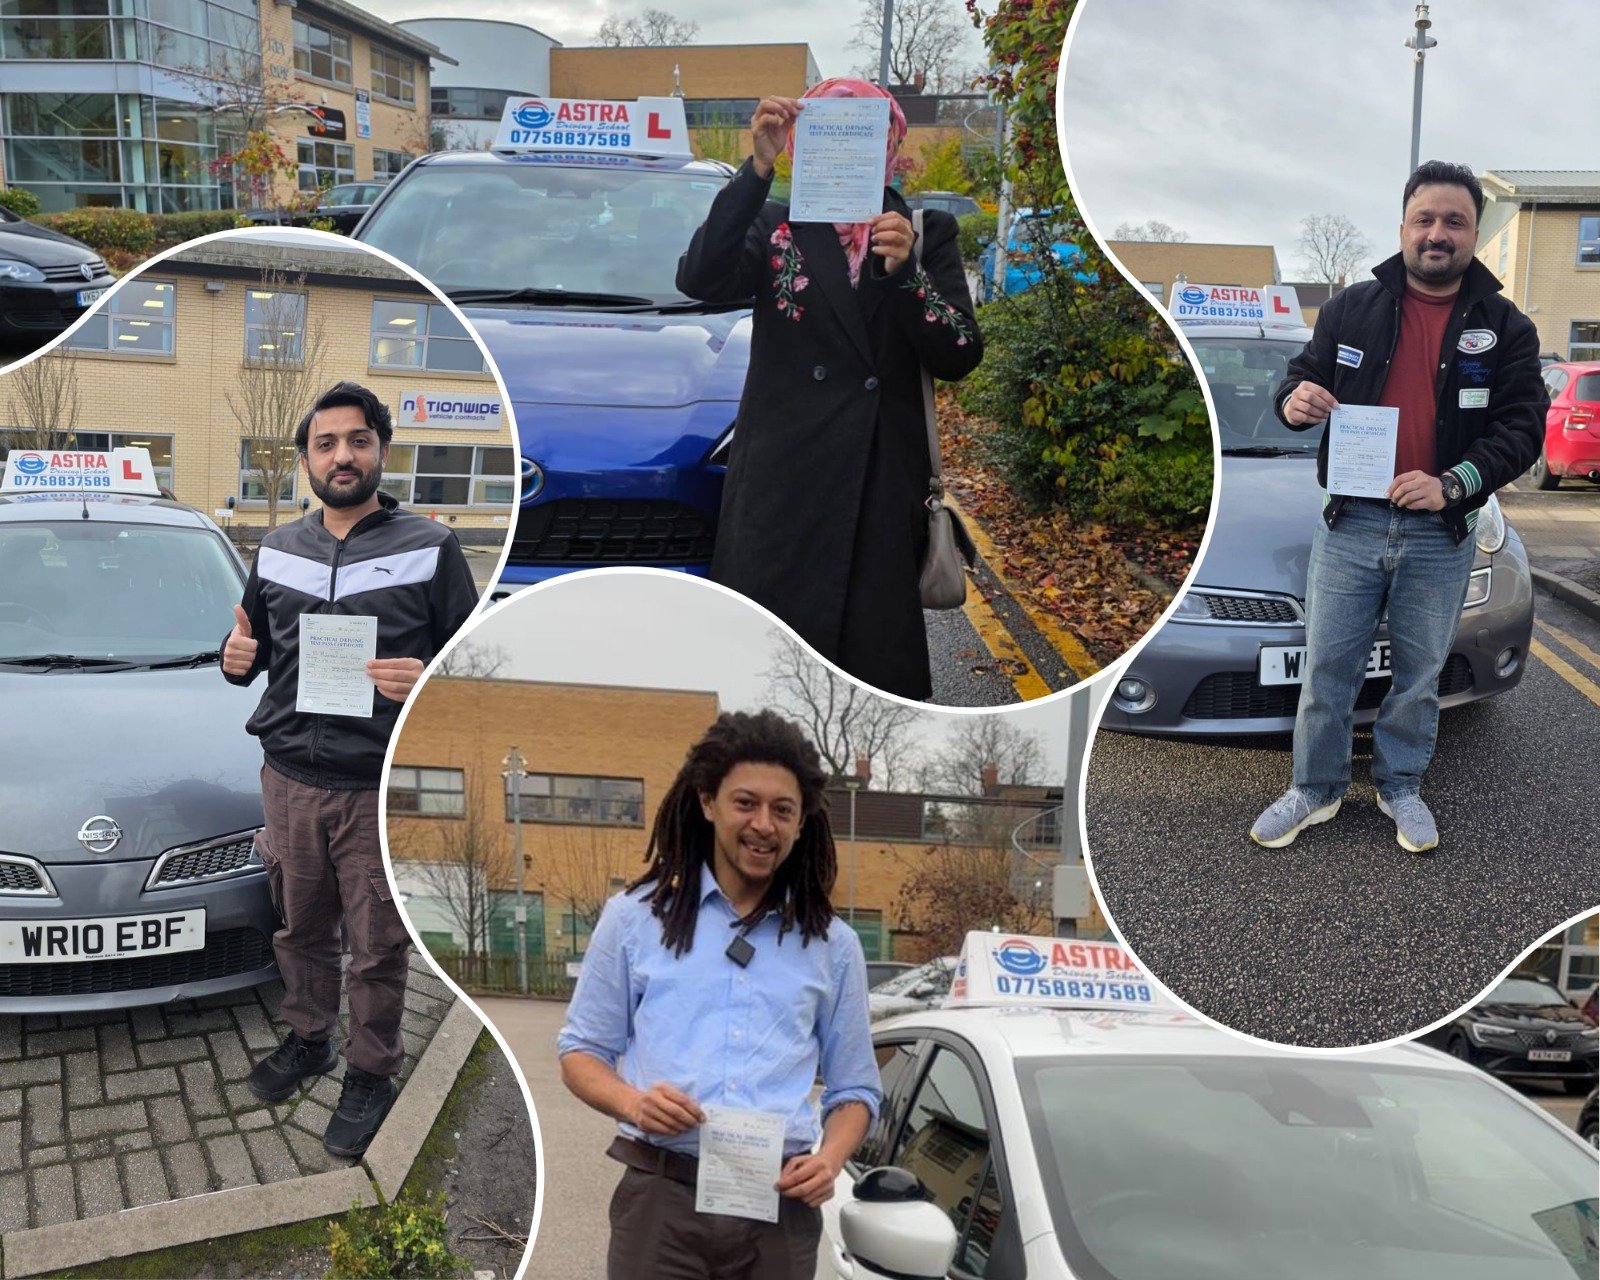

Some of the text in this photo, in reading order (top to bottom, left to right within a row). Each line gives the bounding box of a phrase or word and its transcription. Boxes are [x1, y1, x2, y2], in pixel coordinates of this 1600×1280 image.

[556, 103, 629, 122] ASTRA
[556, 121, 630, 131] Driving School
[647, 113, 671, 139] L
[510, 130, 631, 147] 07758837589
[1210, 287, 1260, 302] ASTRA
[1179, 305, 1263, 318] 07758837589
[1273, 296, 1290, 313] L
[51, 453, 107, 468] ASTRA
[50, 467, 80, 475] Driving
[122, 459, 142, 480] L
[14, 475, 111, 487] 07758837589
[82, 831, 119, 839] NISSAN
[22, 916, 186, 957] WR10 EBF
[1051, 943, 1140, 971] ASTRA
[1052, 966, 1145, 981] Driving School
[998, 976, 1151, 1001] 07758837589
